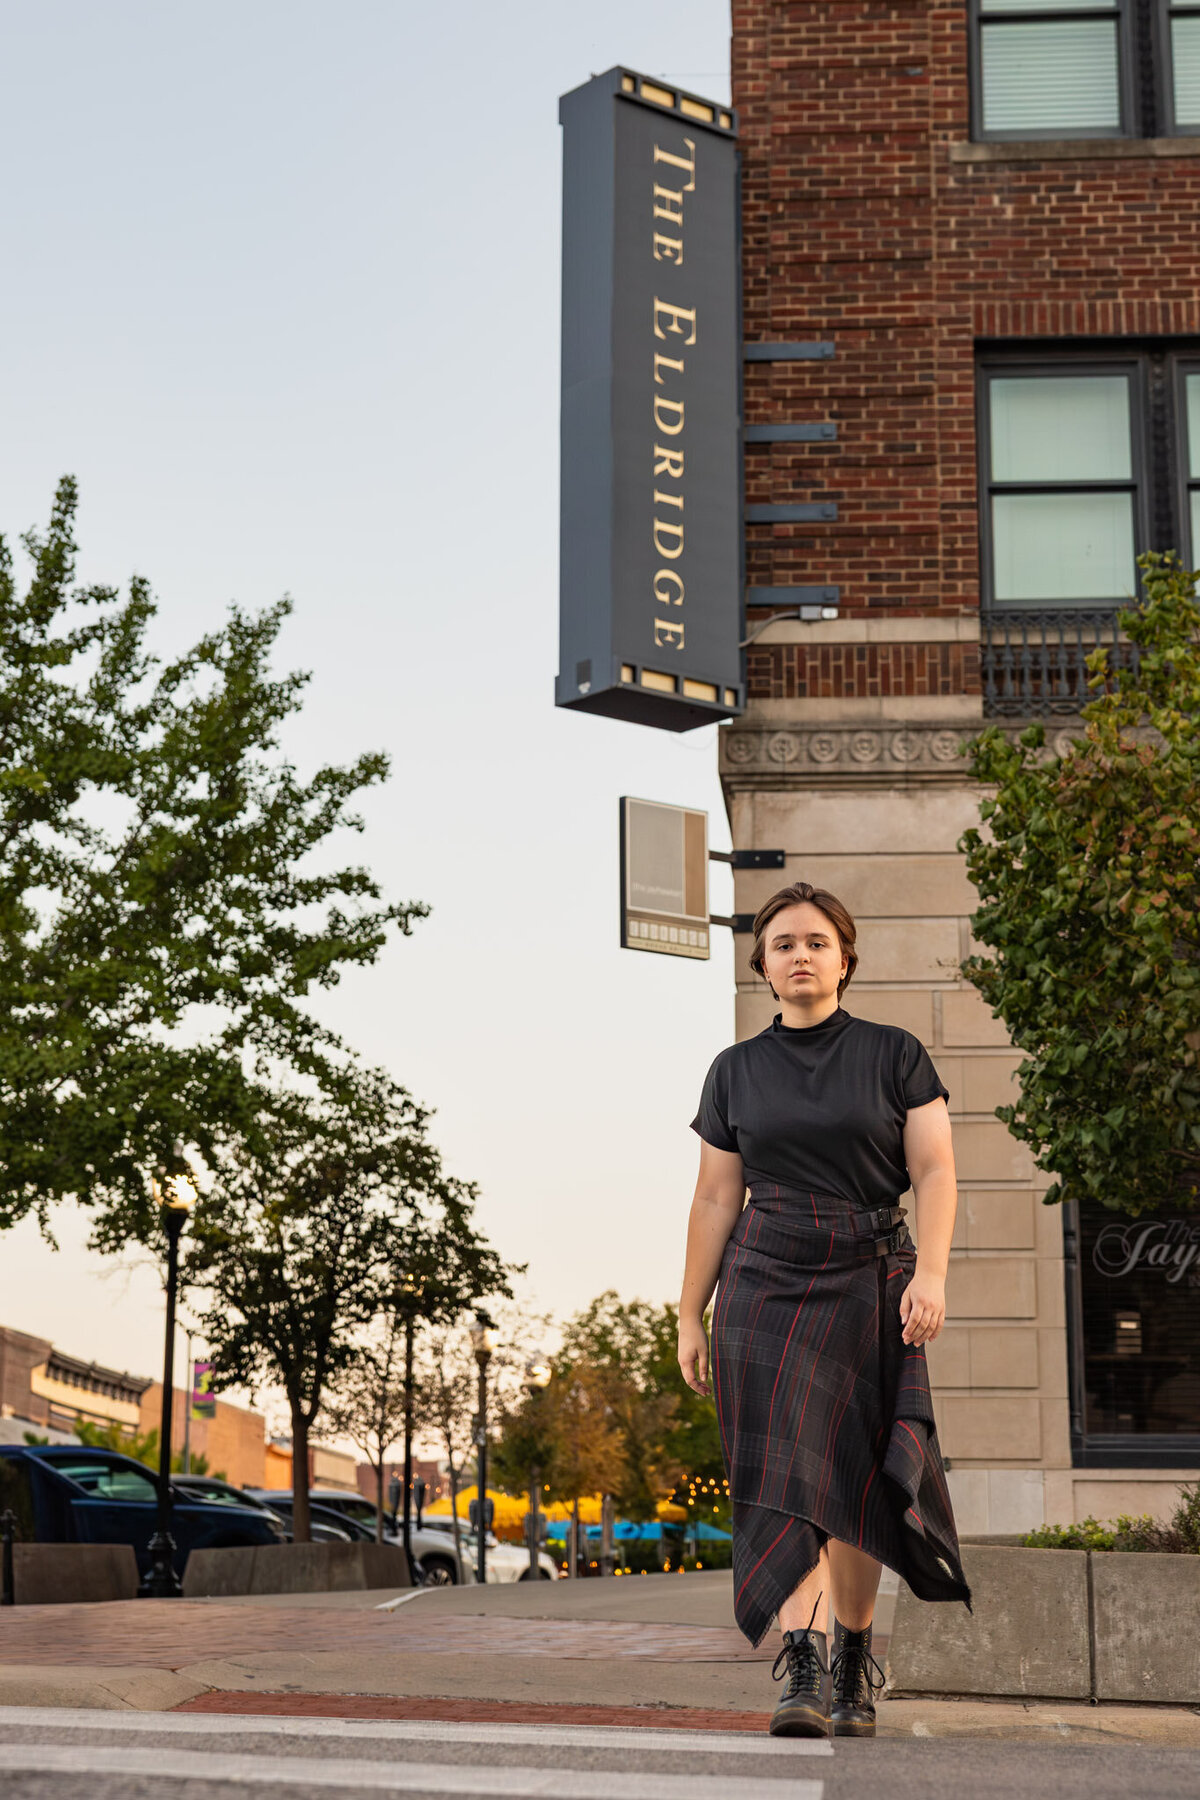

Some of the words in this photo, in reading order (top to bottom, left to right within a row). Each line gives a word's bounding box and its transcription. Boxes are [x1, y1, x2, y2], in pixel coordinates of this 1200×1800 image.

[653, 137, 696, 266] THE
[653, 296, 697, 650] ELDRIDGE
[1092, 1221, 1200, 1284] Jay
